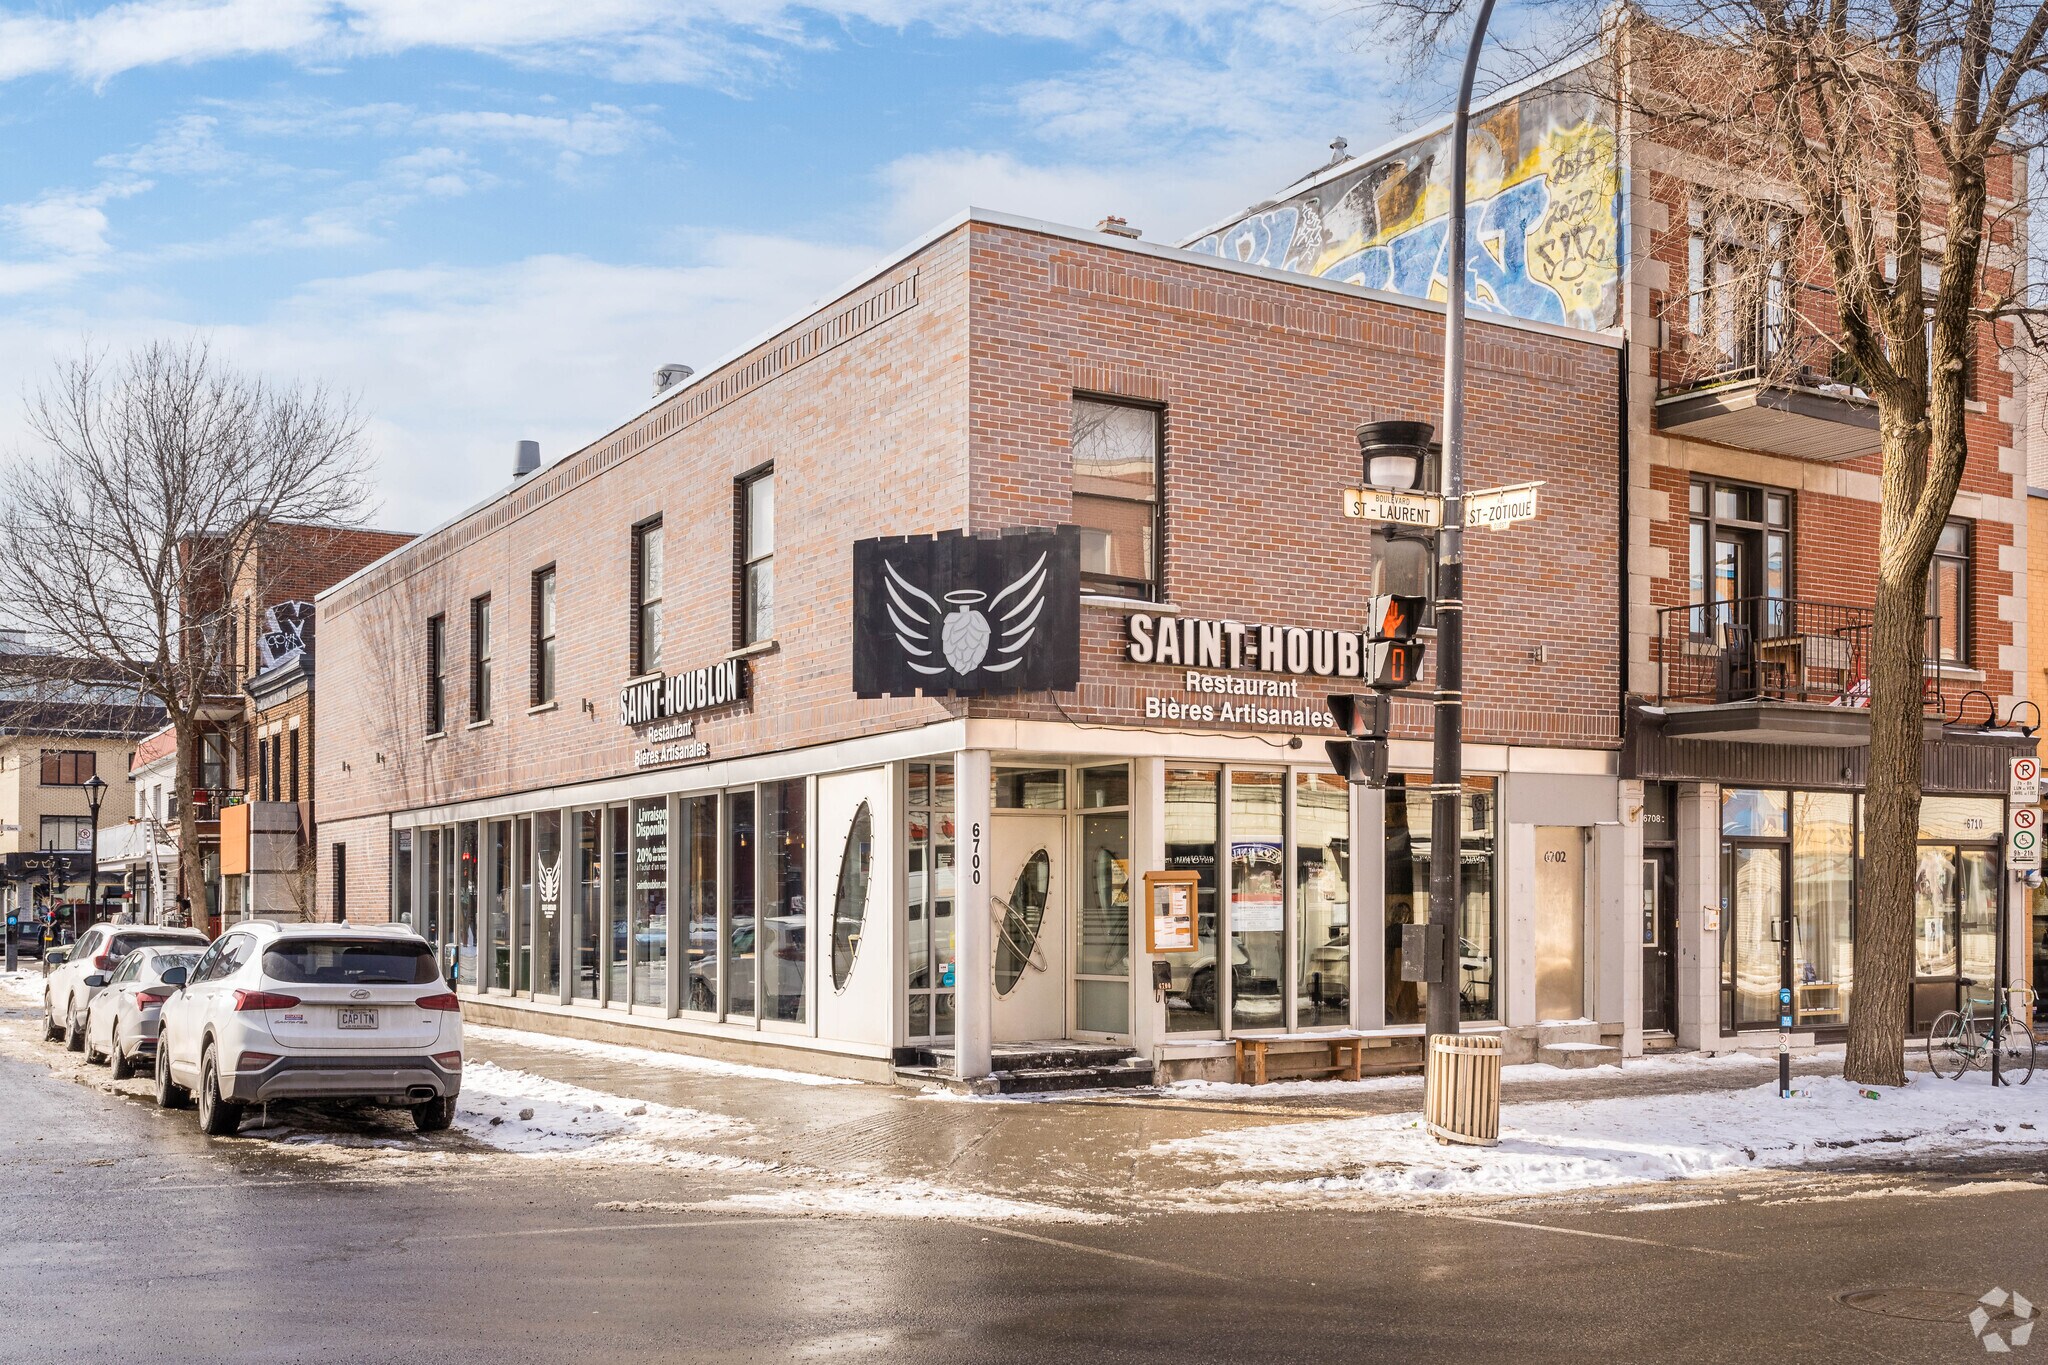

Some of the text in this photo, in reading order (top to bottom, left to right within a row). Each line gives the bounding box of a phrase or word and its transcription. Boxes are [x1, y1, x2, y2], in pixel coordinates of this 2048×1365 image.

[1375, 494, 1411, 506] BOULEVARD
[1469, 501, 1532, 524] ST-ZOTIQUE
[1129, 613, 1424, 681] SAINT-HOUB
[620, 659, 737, 726] SAINT-HOUBLON
[1186, 671, 1298, 698] Restaurant
[1145, 697, 1334, 728] Bières Artisanales
[648, 719, 693, 743] Restaurant
[634, 741, 707, 767] Bières Artisanales
[636, 847, 652, 863] 20%
[972, 822, 981, 885] 6700
[342, 1014, 375, 1024] CAPITN
